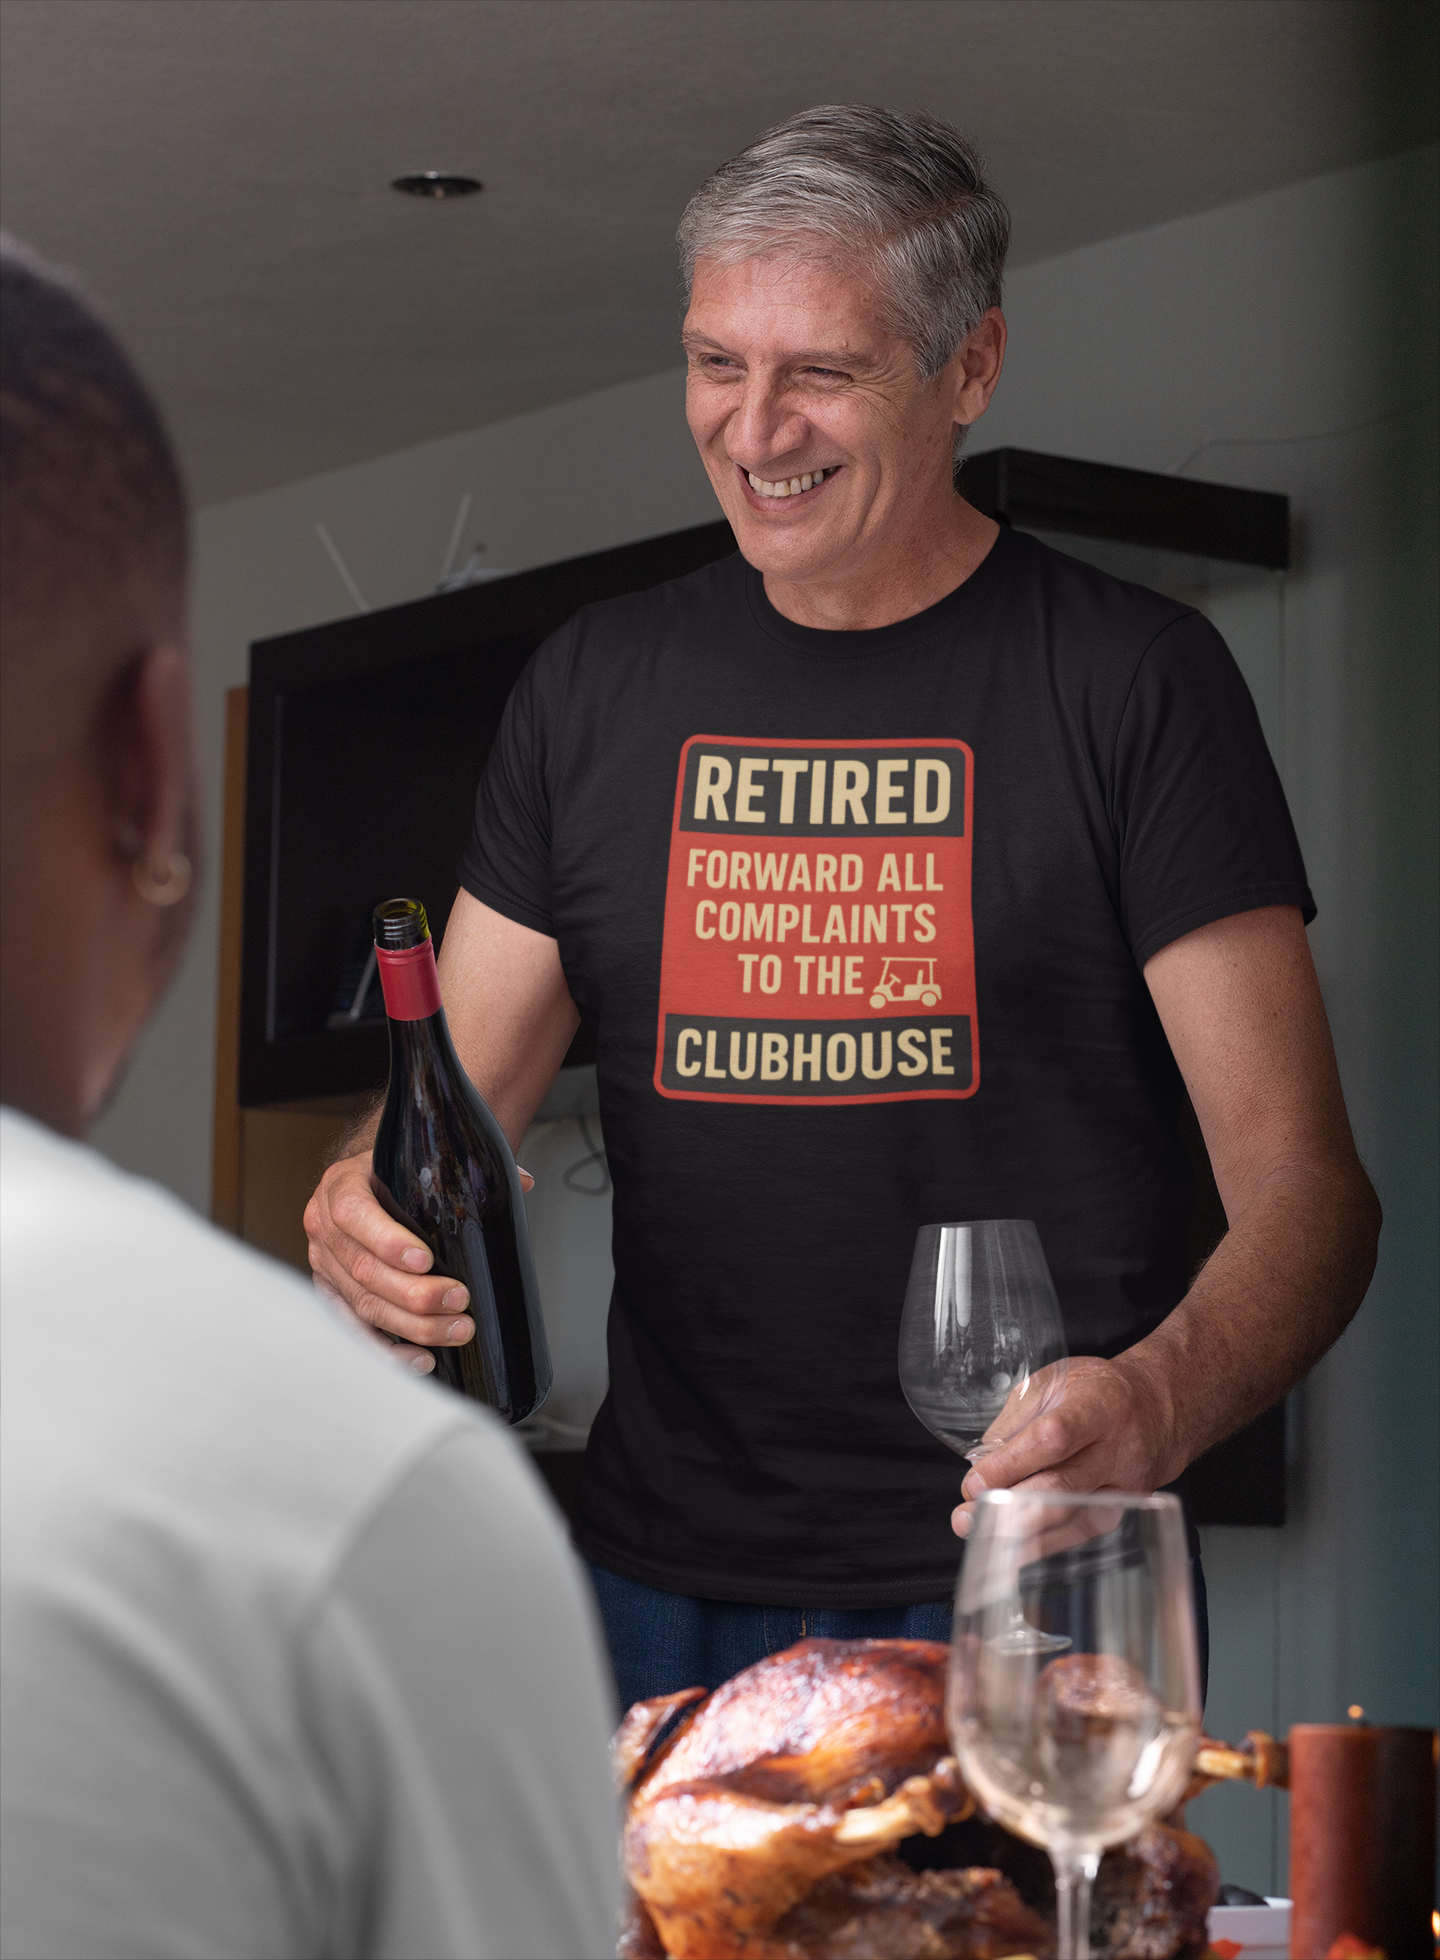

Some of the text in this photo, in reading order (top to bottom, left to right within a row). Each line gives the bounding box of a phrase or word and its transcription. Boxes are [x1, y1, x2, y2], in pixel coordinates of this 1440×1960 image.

[693, 755, 951, 825] RETIRED
[687, 848, 944, 893] FORWARD ALL
[695, 900, 937, 944] COMPLAINTS
[738, 954, 864, 995] TO THE
[676, 1028, 955, 1082] CLUBHOUSE
